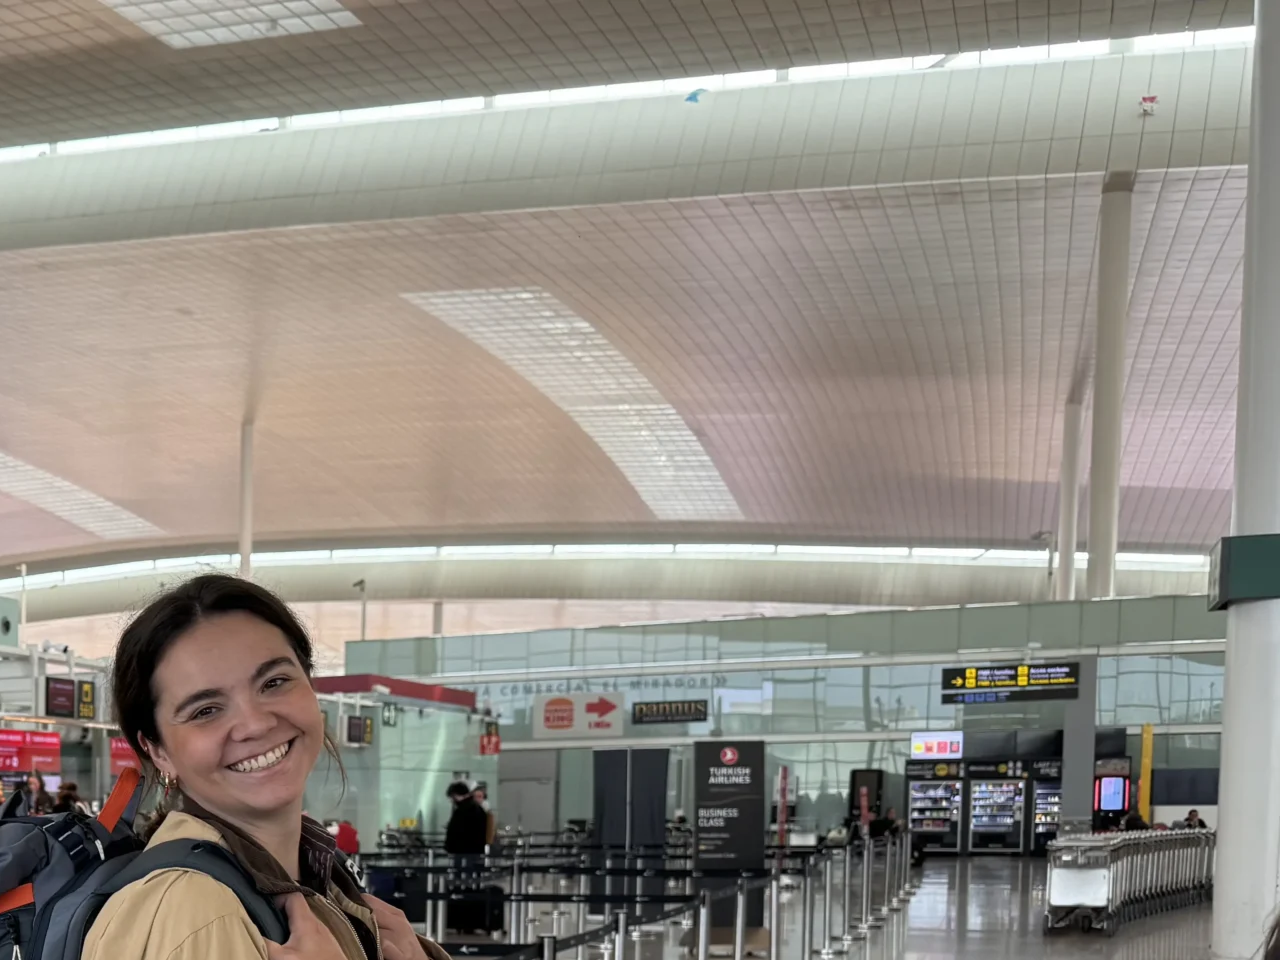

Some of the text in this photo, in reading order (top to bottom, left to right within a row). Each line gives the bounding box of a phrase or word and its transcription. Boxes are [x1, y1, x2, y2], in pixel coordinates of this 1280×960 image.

[634, 702, 706, 718] pannus
[708, 767, 751, 776] TURKISH
[708, 775, 751, 785] AIRLINES
[698, 808, 739, 818] BUSINESS
[698, 818, 725, 827] CLASS
